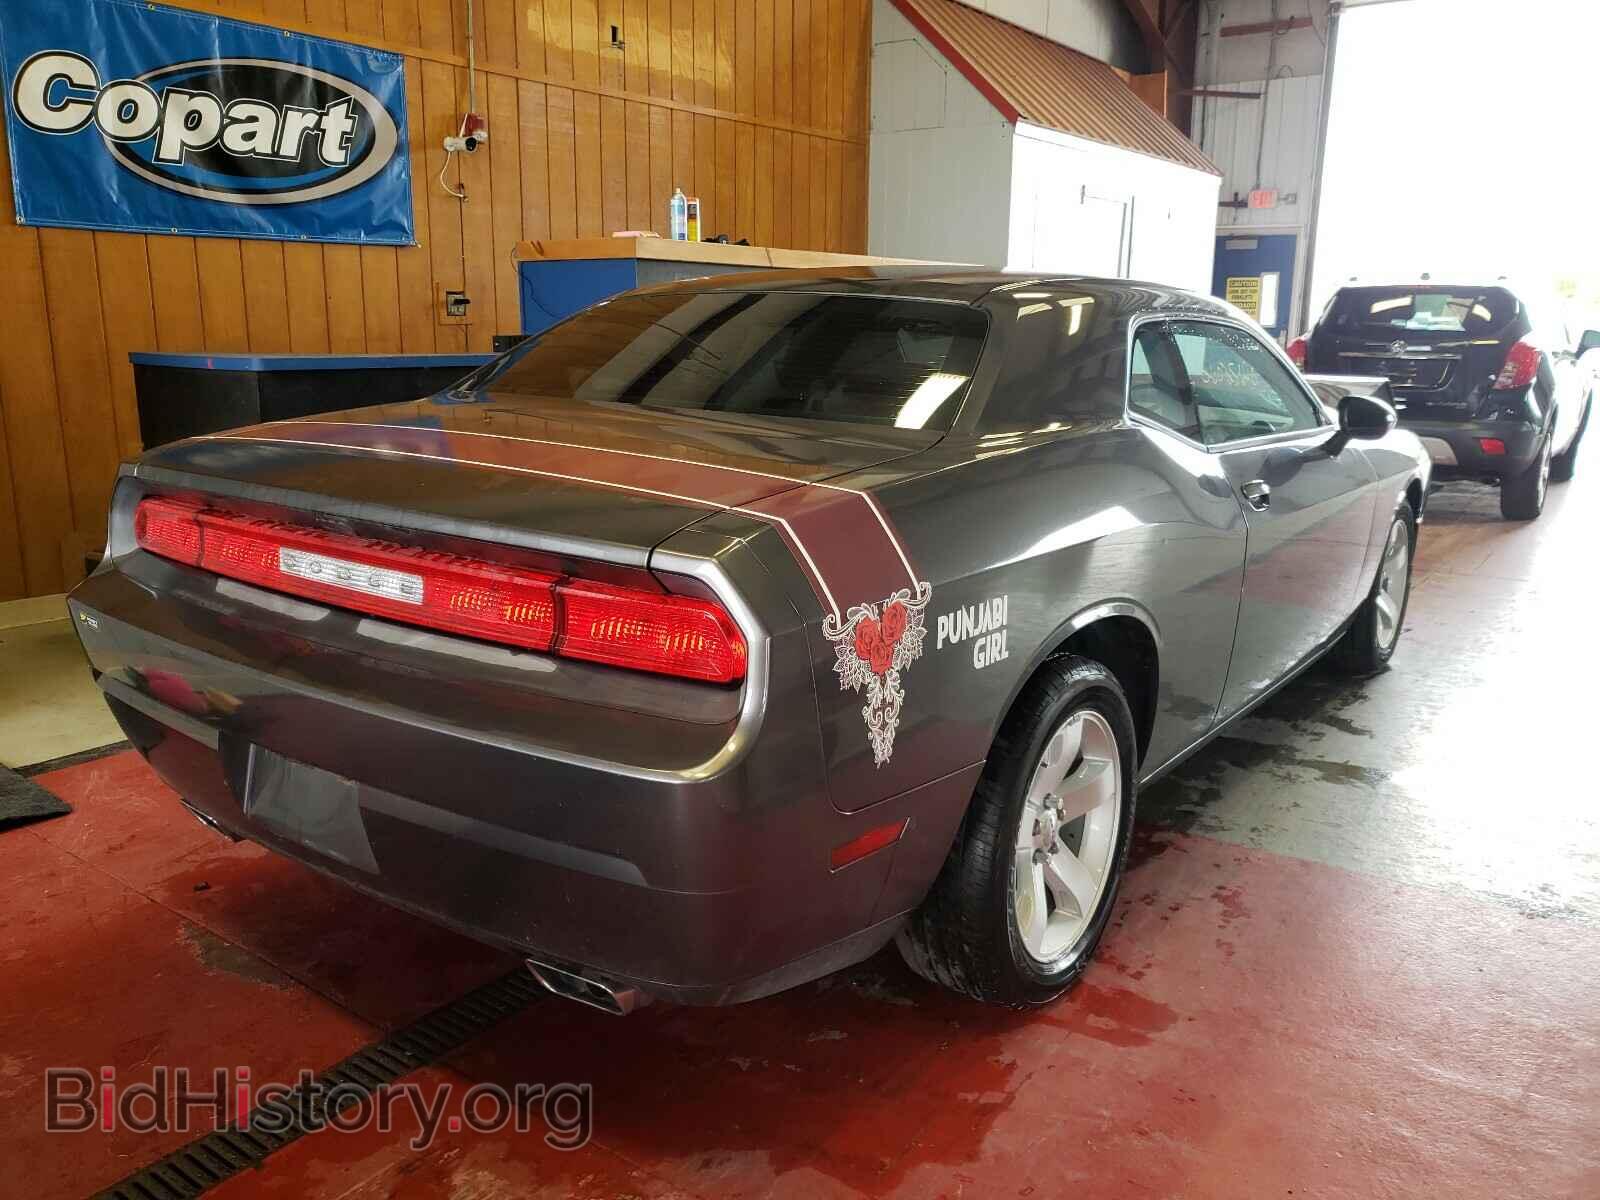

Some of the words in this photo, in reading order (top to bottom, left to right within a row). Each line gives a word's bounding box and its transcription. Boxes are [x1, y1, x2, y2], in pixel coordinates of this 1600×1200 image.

[13, 50, 357, 167] Copart
[936, 595, 1008, 649] PUNJABI
[973, 630, 1008, 669] GIRL
